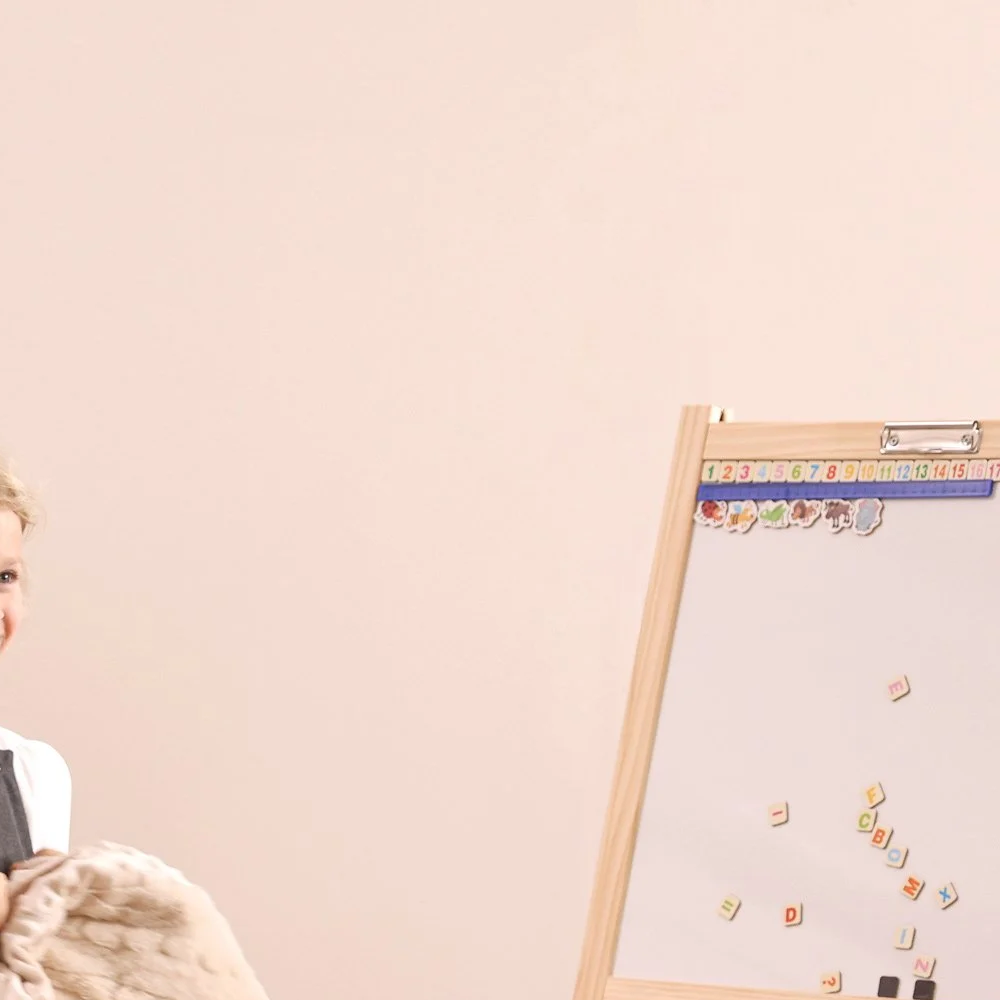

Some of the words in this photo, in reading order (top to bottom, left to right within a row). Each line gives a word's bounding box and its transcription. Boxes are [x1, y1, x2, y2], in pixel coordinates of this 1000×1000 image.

[708, 464, 714, 479] 1
[722, 464, 733, 479] 2
[740, 464, 750, 479] 3
[758, 464, 767, 479] 4
[774, 464, 785, 479] 5
[791, 464, 802, 479] 6
[809, 464, 820, 479] 7
[826, 464, 837, 479] 8
[843, 464, 855, 479] 9
[861, 464, 875, 479] 10
[879, 464, 892, 479] 11
[896, 464, 910, 479] 12
[915, 464, 929, 479] 13
[933, 463, 947, 478] 14
[951, 463, 965, 478] 15
[970, 463, 985, 478] 16
[989, 463, 1000, 478] 17
[888, 680, 904, 695] E
[866, 786, 878, 804] F
[858, 813, 871, 829] C
[872, 828, 886, 845] B
[887, 848, 901, 863] O
[785, 907, 797, 922] D
